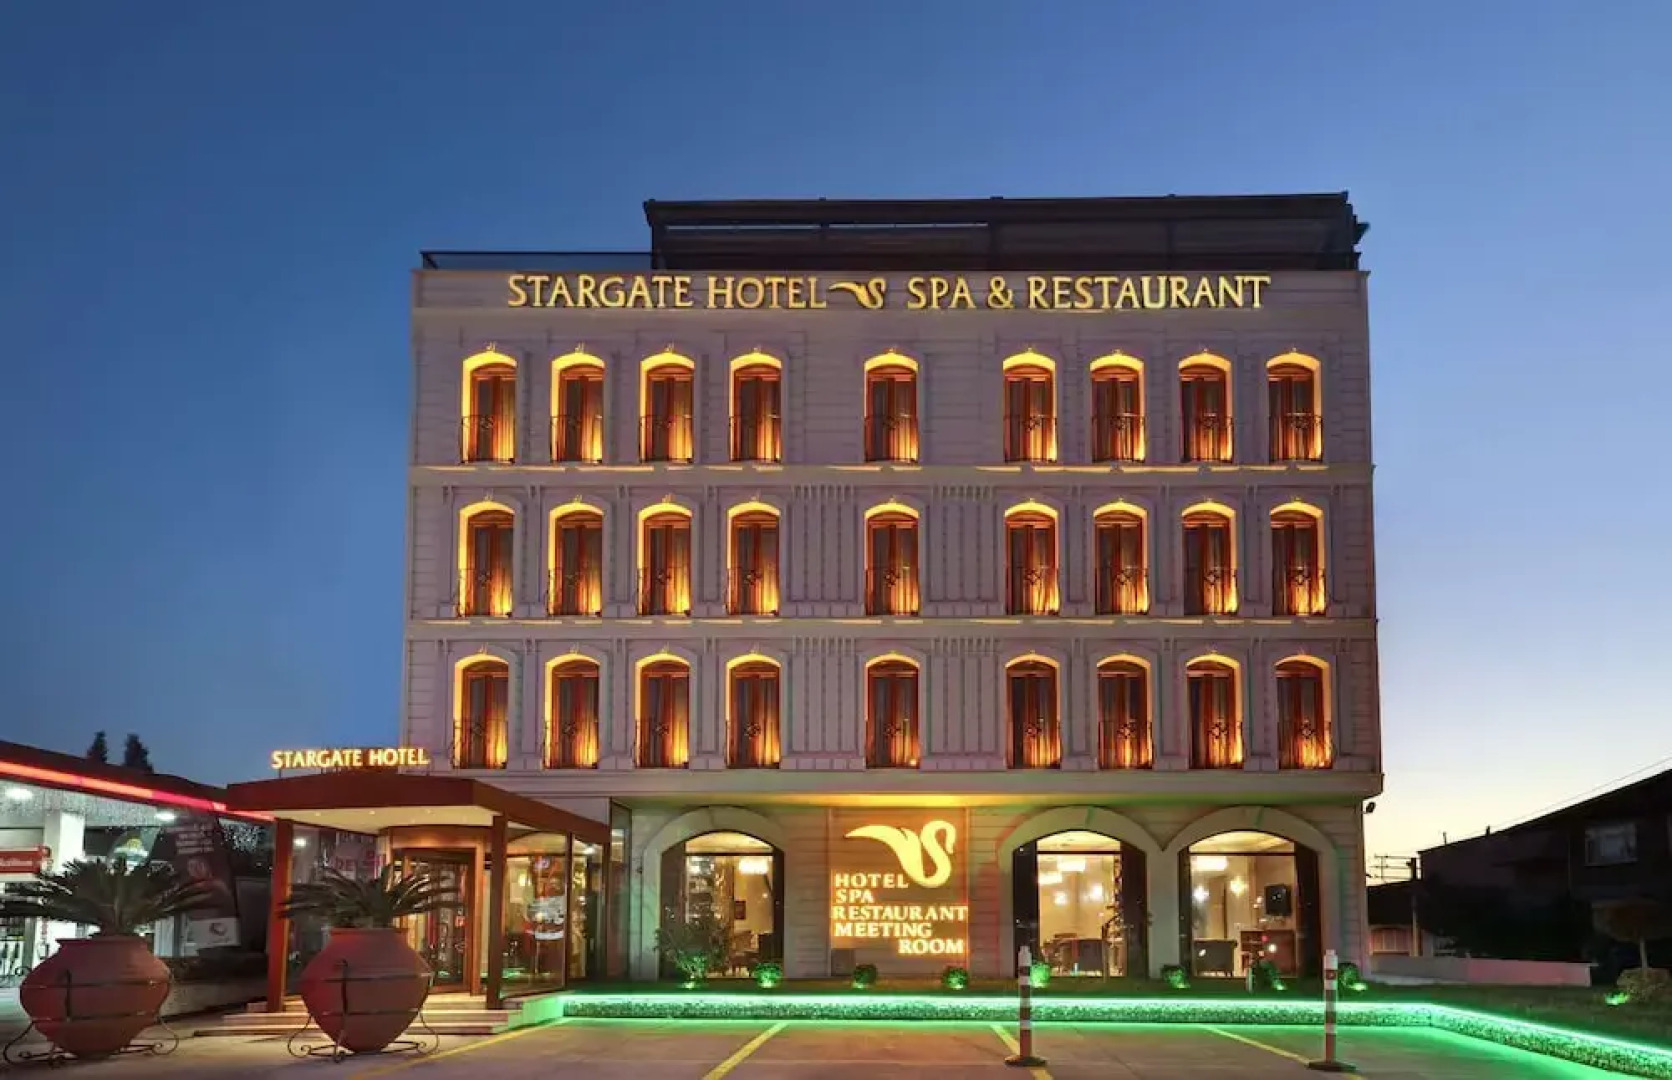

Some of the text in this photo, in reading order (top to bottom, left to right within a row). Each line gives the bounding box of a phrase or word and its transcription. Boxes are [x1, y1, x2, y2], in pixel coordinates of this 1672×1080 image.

[506, 274, 1271, 310] STARGATE HOTEL SPA & RESTAURANT
[271, 748, 430, 769] STARGATE HOTEL
[835, 873, 909, 889] HOTEL
[835, 889, 875, 904] SPA
[831, 905, 968, 921] RESTAURANT
[834, 922, 932, 938] MEETING
[898, 938, 964, 954] ROOM
